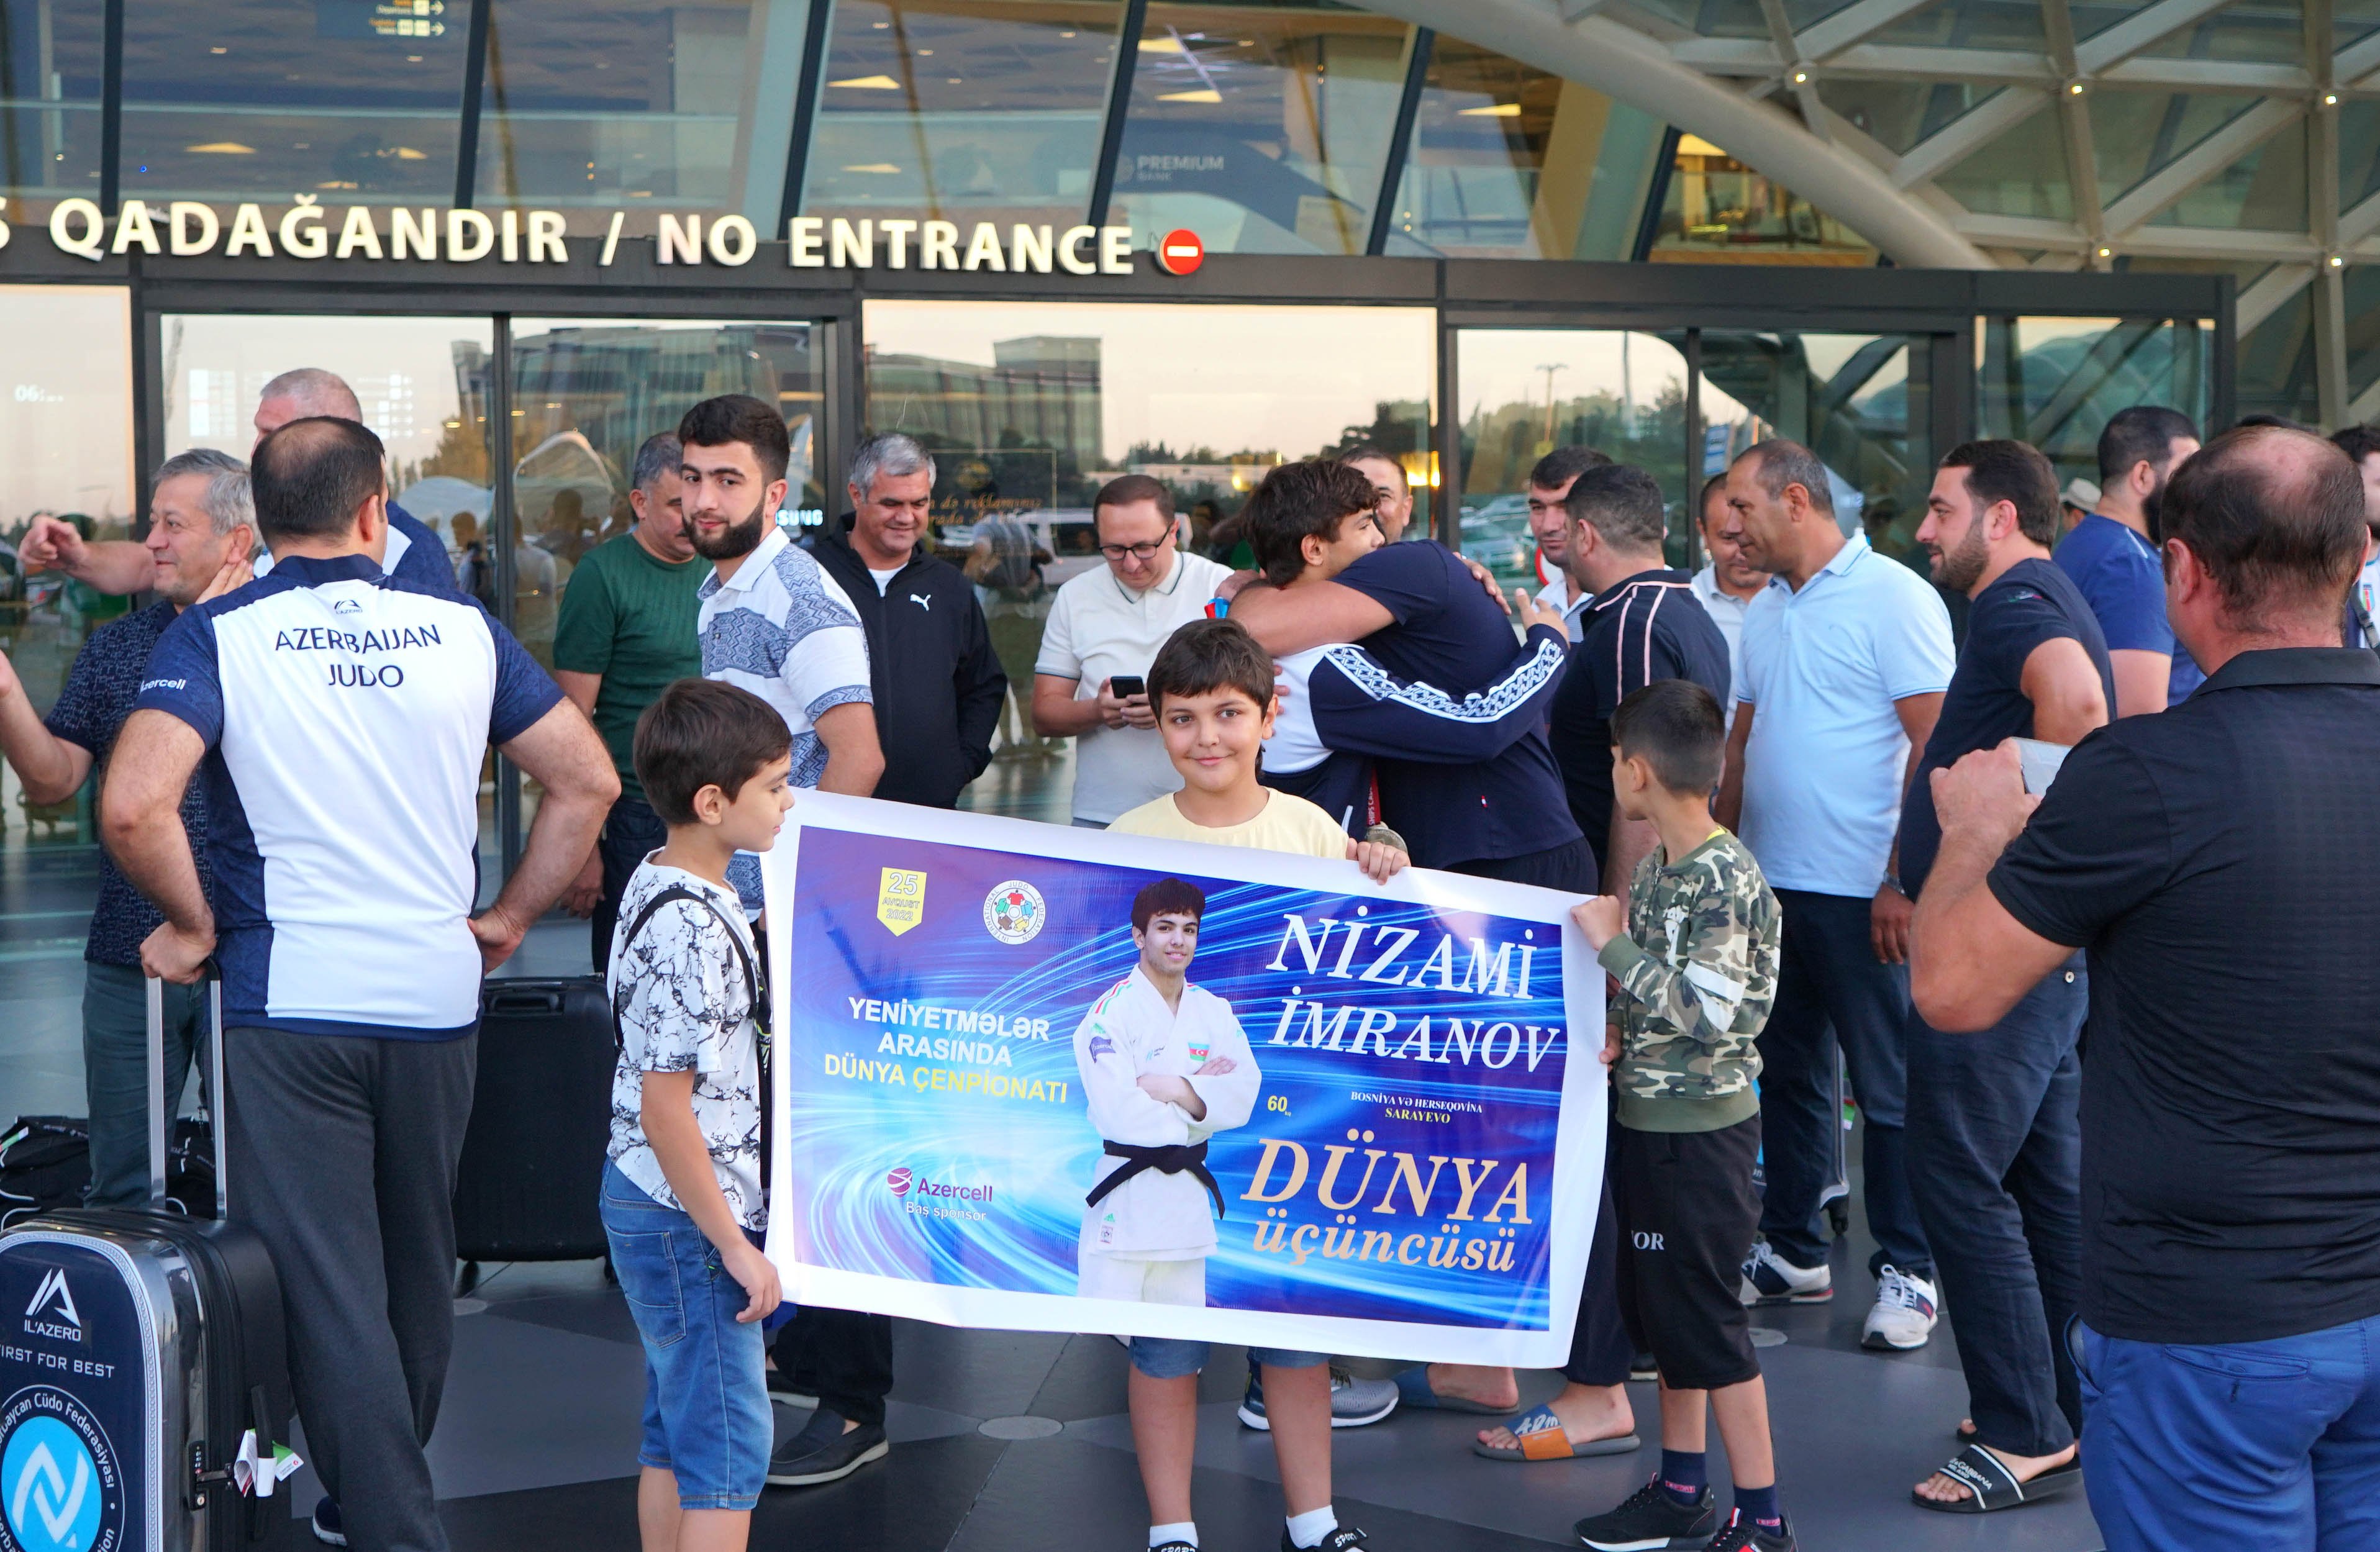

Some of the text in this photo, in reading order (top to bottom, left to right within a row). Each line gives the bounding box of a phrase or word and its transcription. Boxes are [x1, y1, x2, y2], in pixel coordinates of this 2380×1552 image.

[1137, 155, 1225, 171] PREMIUM
[50, 193, 569, 263] QADAĞANDIR
[599, 212, 625, 266] /
[656, 213, 757, 267] NO
[789, 217, 1134, 275] ENTRANCE
[275, 624, 442, 655] AZERBAIJAN
[329, 664, 404, 688] JUDO
[888, 872, 918, 896] 25
[886, 908, 914, 922] 2022
[984, 881, 1045, 942] INTERNATIONAL JUDO FEDERATION
[1265, 905, 1537, 1000] NİZAMİ
[848, 997, 1050, 1041] YENİYETMƏLƏR
[1268, 986, 1560, 1073] İMRANOV
[878, 1032, 1013, 1067] ARASINDA
[824, 1052, 1068, 1104] DÜNYA ÇENPİONATI
[1268, 1095, 1288, 1112] 60
[1351, 1091, 1483, 1114] BOSNİYA VƏ HERSEQOVİNA
[1385, 1107, 1450, 1123] SARAYEVO
[917, 1178, 992, 1202] Azercell
[1240, 1128, 1532, 1225] DÜNYA
[906, 1200, 986, 1222] Baş sponsor
[1253, 1207, 1515, 1273] üçüncüsü
[24, 1319, 81, 1342] IL'AZERO
[0, 1344, 115, 1378] IRST FOR BEST
[34, 1392, 63, 1412] Cüdo
[65, 1402, 115, 1488] Federasiyası
